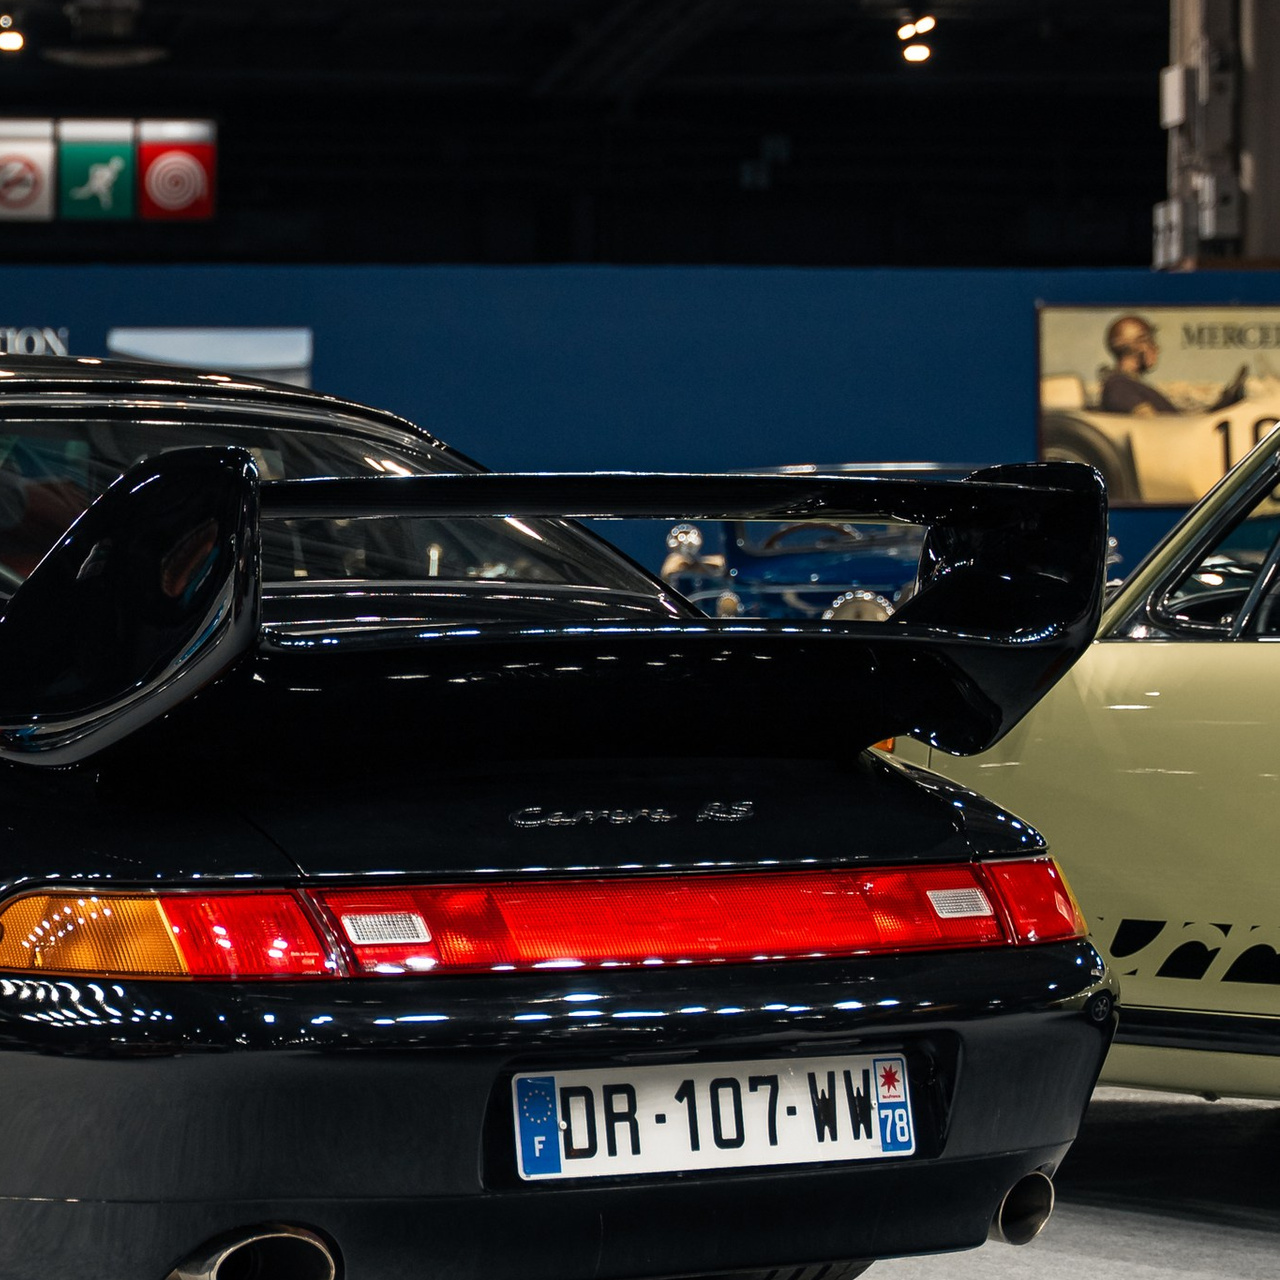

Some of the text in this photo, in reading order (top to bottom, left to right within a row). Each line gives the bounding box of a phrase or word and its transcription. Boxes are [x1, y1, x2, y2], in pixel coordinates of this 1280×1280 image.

[509, 801, 754, 828] Carrera RS
[534, 1069, 910, 1160] F DR-107-WW 78
